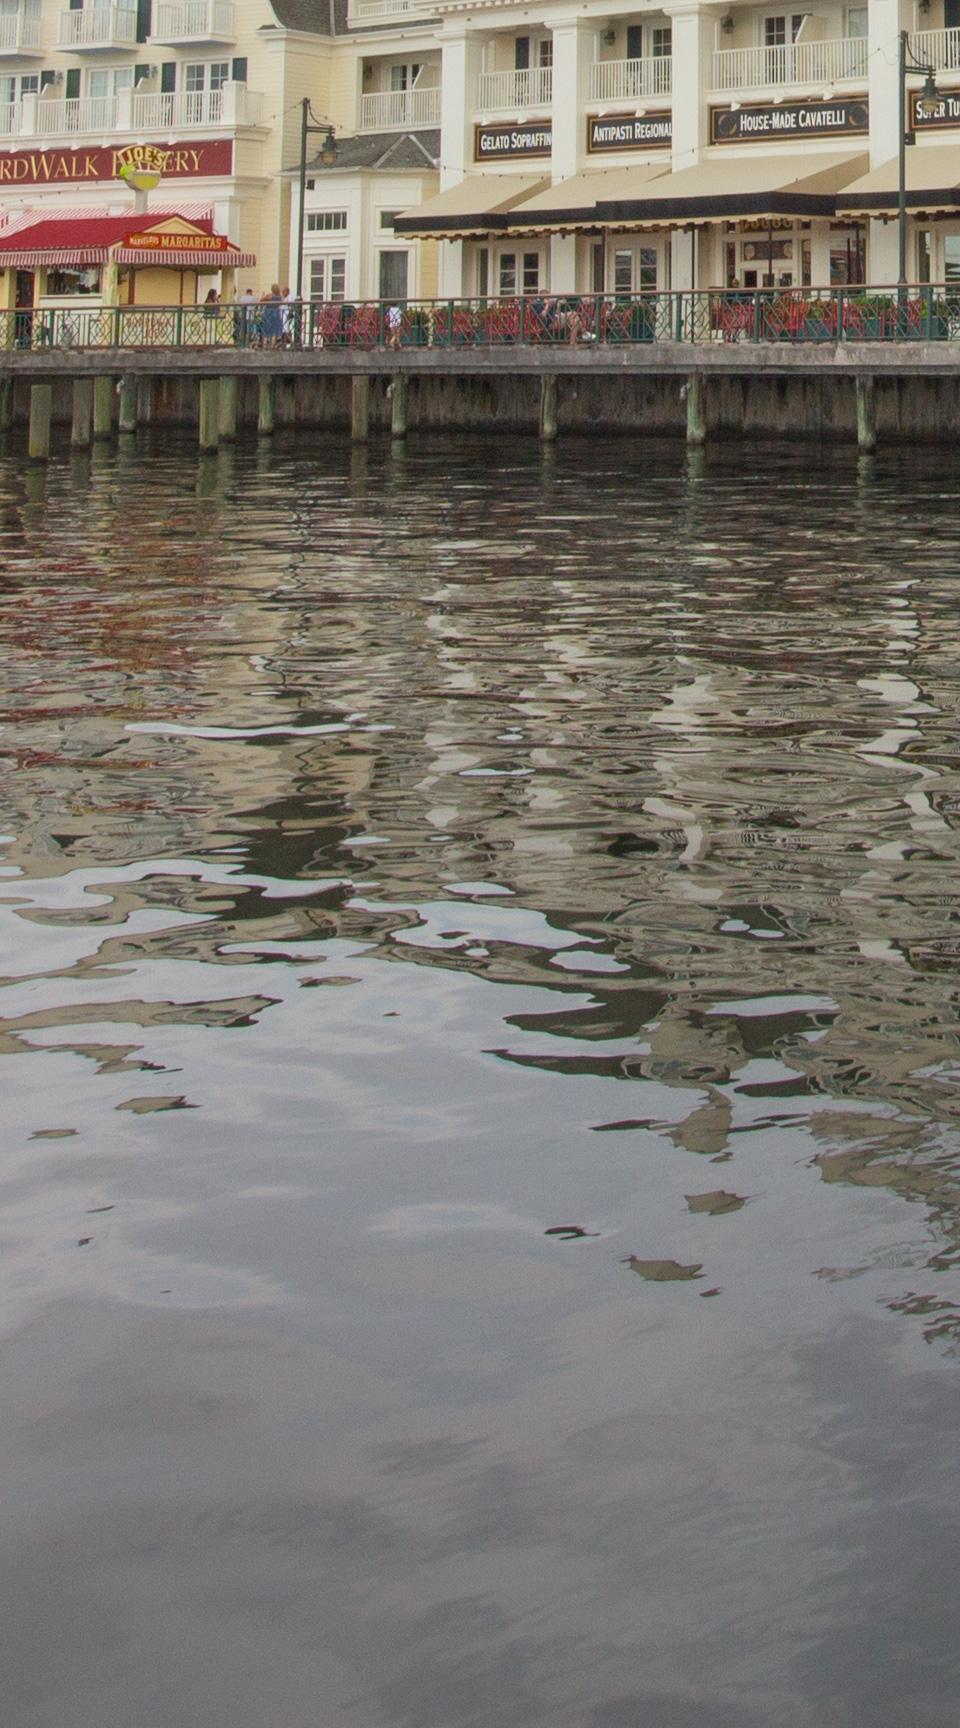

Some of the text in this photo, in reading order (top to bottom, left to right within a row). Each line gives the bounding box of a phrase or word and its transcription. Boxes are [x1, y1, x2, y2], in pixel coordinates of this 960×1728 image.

[916, 101, 945, 119] SER
[740, 110, 845, 131] HOUSE-MADE CAVATELLI
[481, 134, 509, 150] GELATO
[593, 125, 632, 142] ANTIPASTI
[125, 146, 167, 166] JOE'S
[161, 235, 222, 249] MARGARITAS
